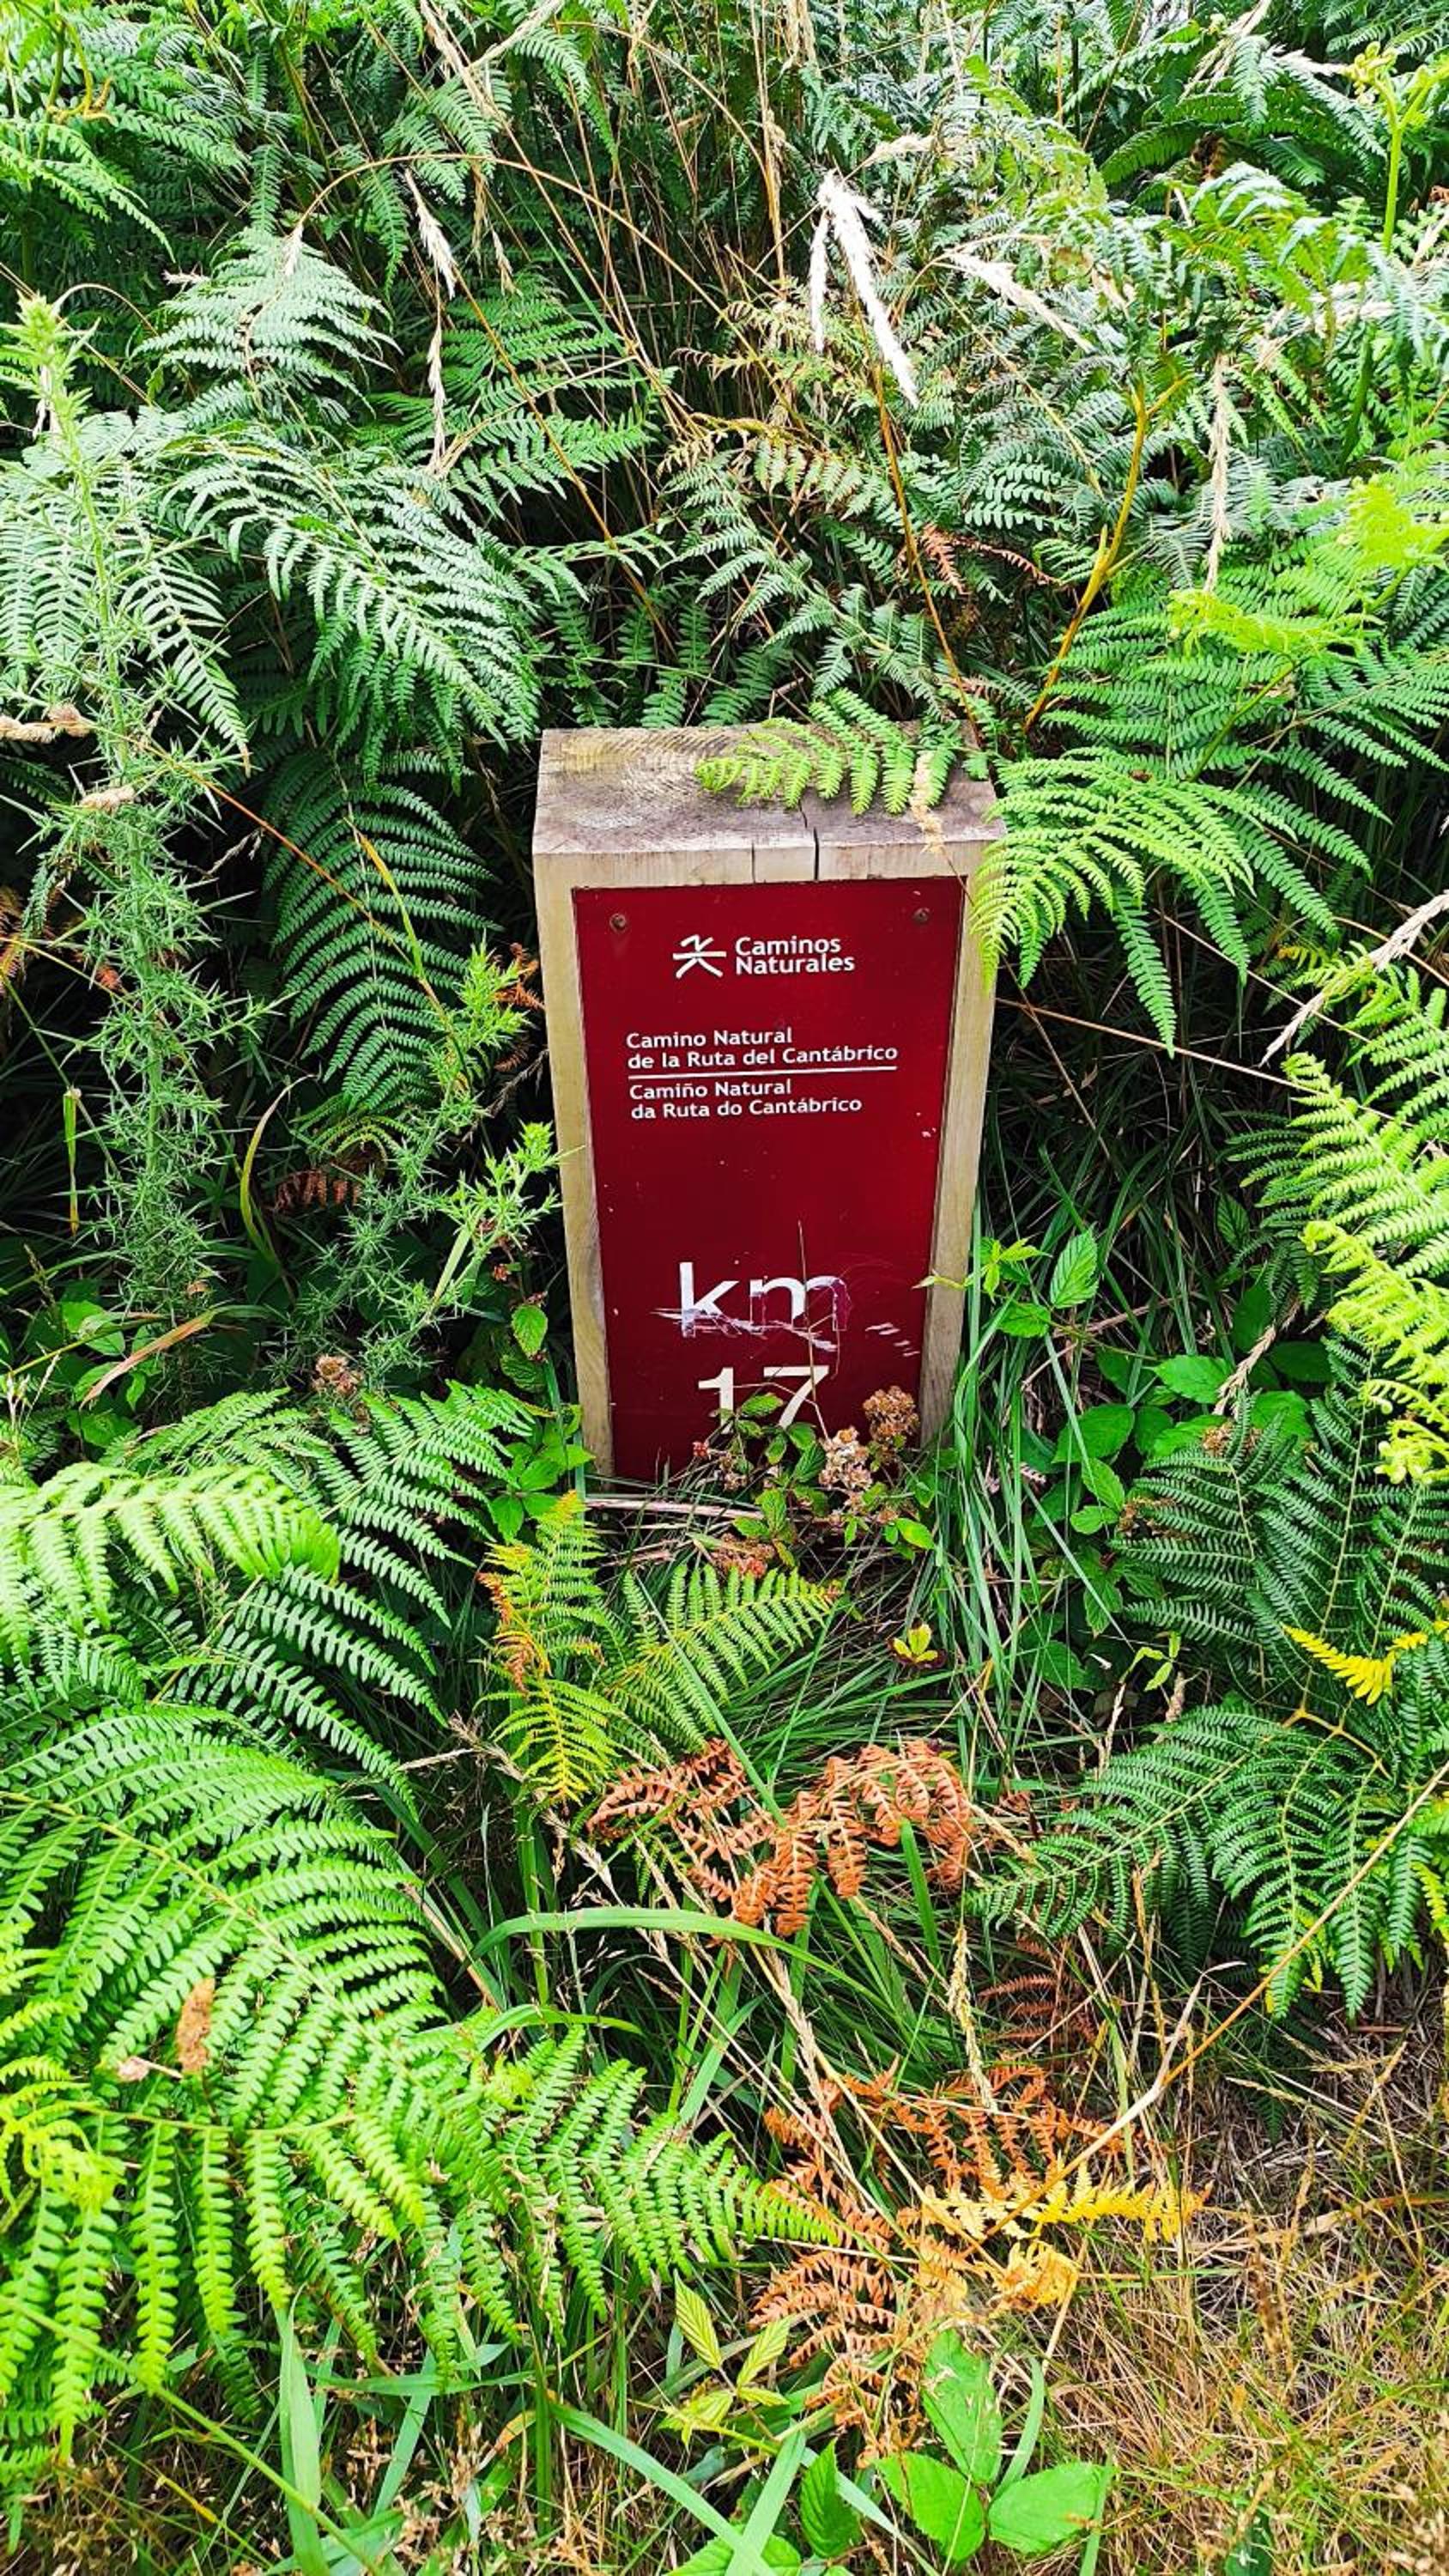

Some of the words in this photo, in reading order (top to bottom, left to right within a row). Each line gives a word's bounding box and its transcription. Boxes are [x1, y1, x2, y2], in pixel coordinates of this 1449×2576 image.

[735, 936, 840, 957] Caminos
[736, 954, 855, 975] Naturales
[626, 1032, 706, 1049] Camino
[713, 1027, 792, 1046] Natural
[628, 1052, 654, 1070] de
[662, 1050, 681, 1068] la
[687, 1051, 736, 1067] Ruta
[743, 1048, 775, 1066] del
[782, 1045, 898, 1064] Cantábrico
[629, 1083, 708, 1101] Camiño
[714, 1078, 791, 1097] Natural
[631, 1103, 657, 1120] da
[663, 1103, 710, 1118] Ruta
[717, 1099, 742, 1116] do
[749, 1097, 862, 1115] Cantábrico
[678, 1261, 848, 1338] km
[698, 1365, 830, 1435] 17
